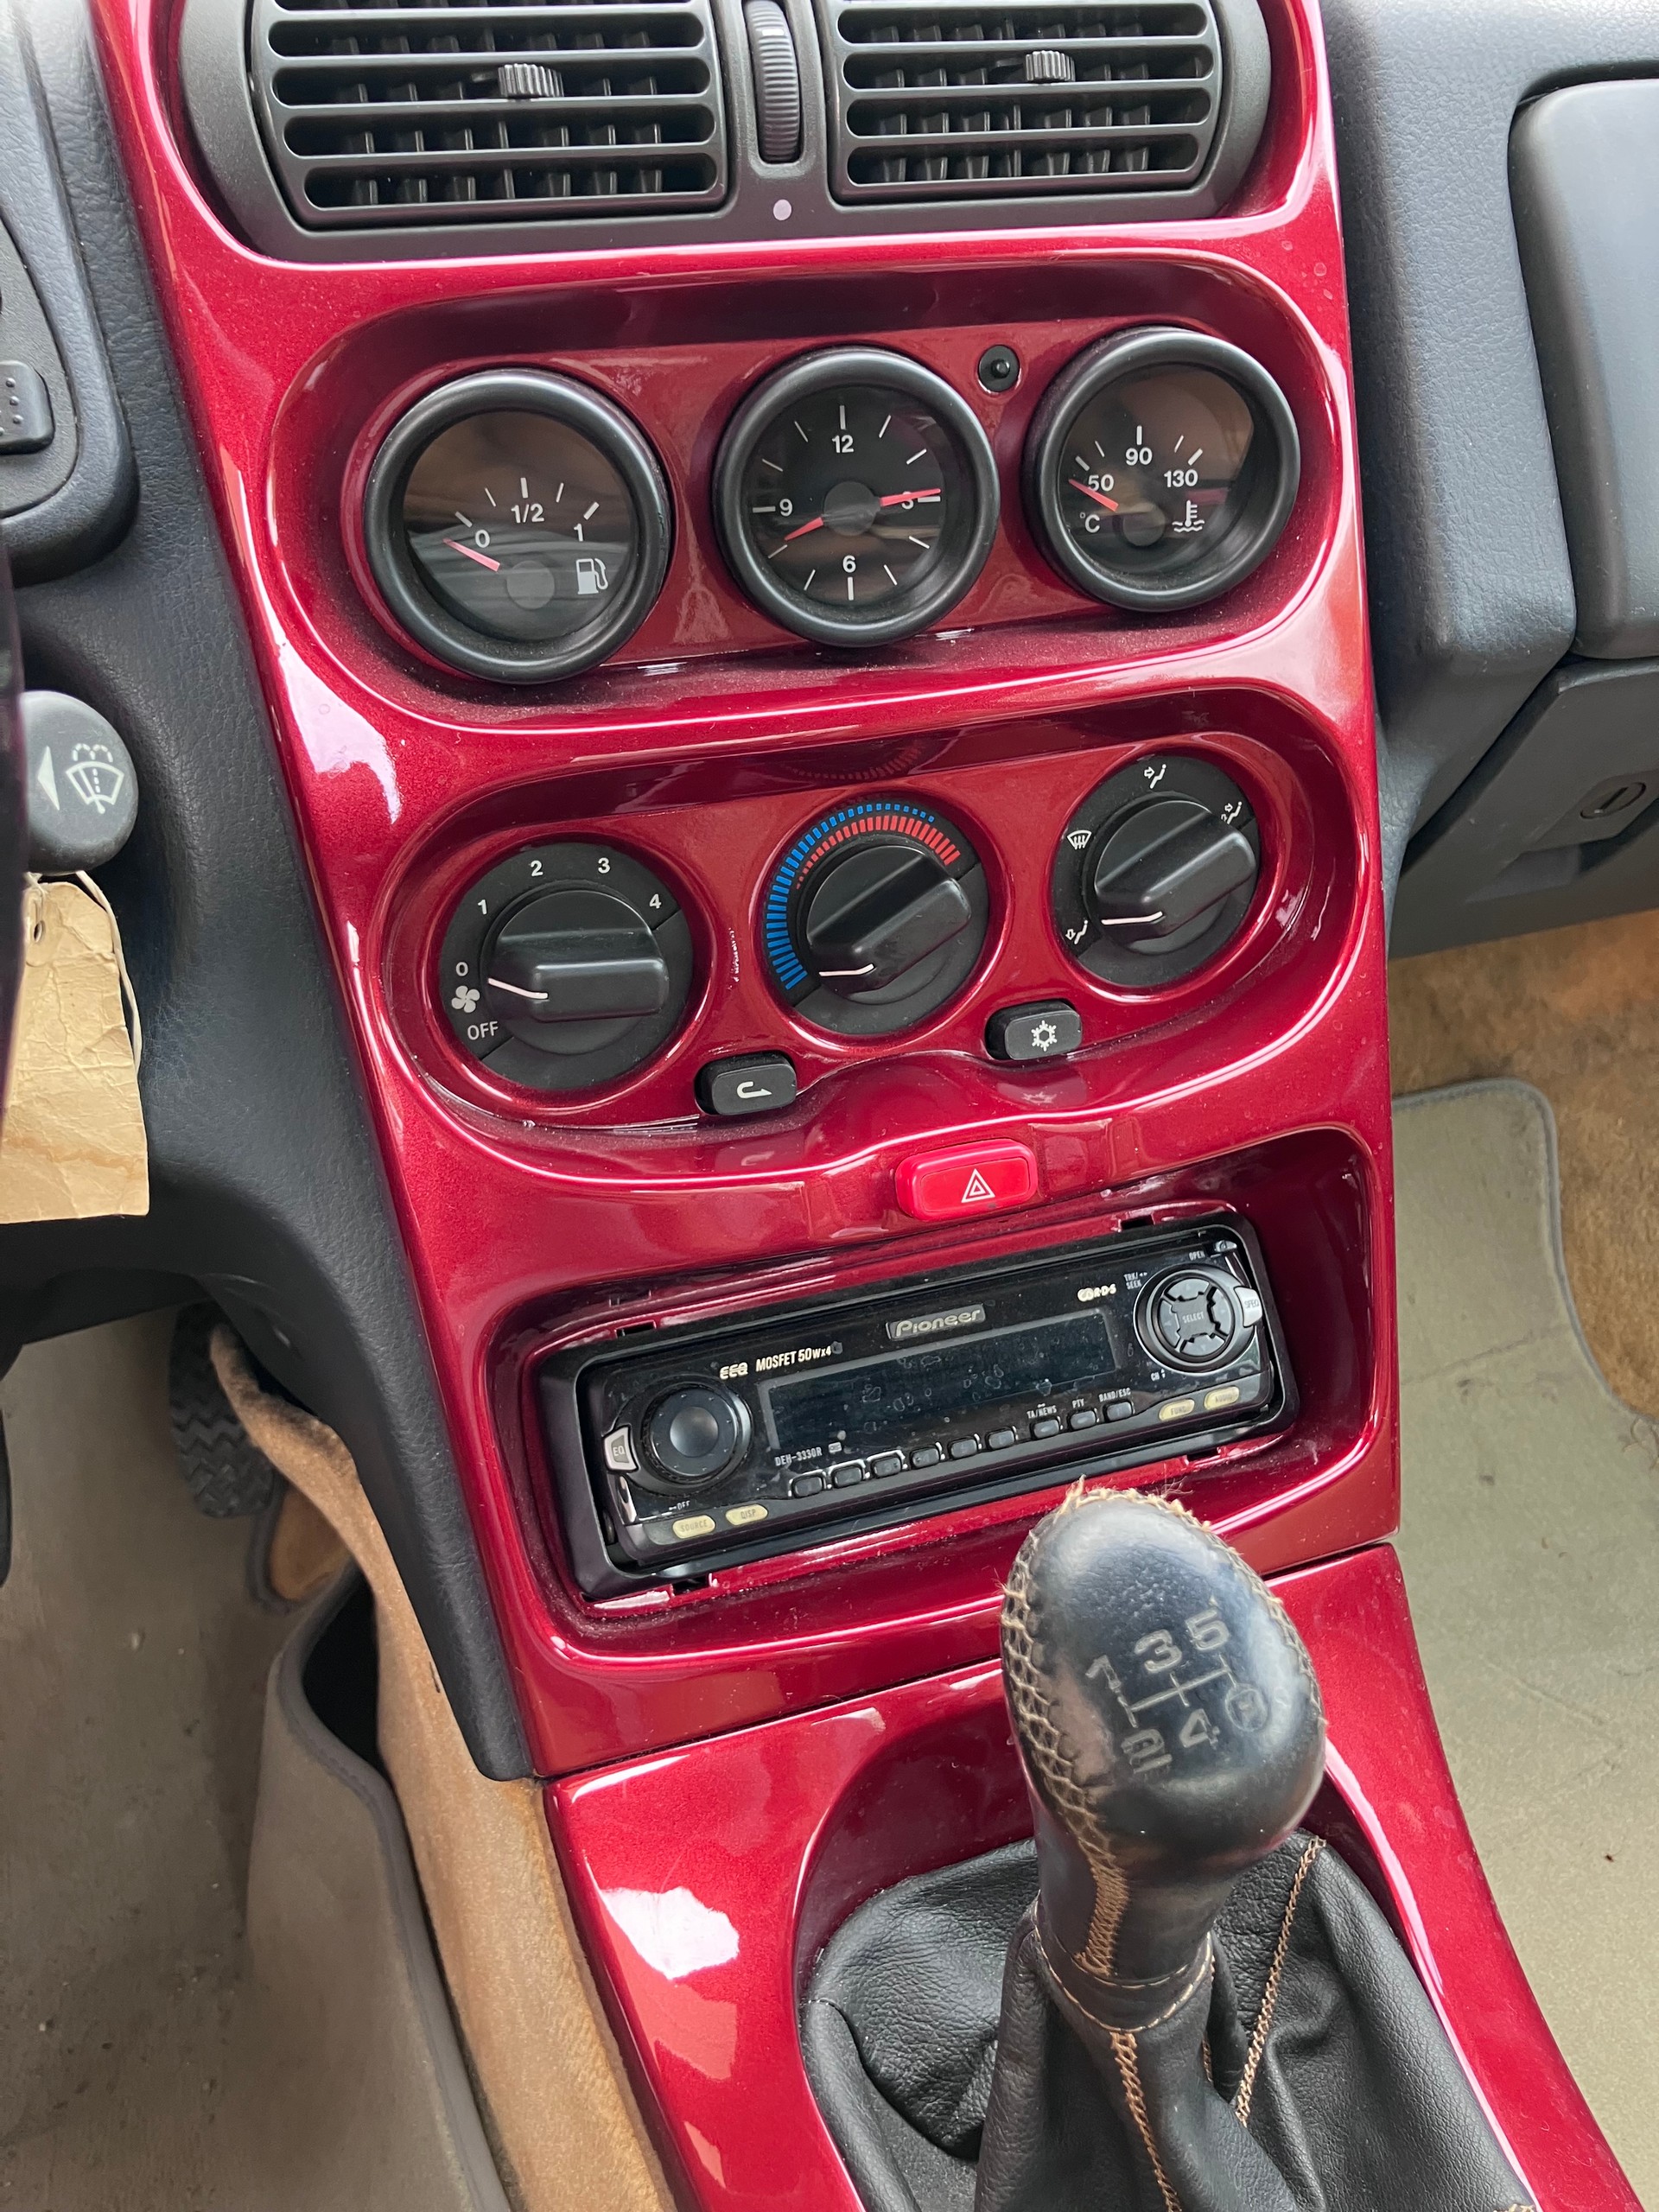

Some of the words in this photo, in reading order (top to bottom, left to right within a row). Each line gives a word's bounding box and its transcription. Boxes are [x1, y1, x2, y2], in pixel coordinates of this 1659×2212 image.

[831, 434, 855, 454] 12
[1125, 447, 1153, 467] 90
[1087, 474, 1115, 493] 50
[1163, 468, 1198, 488] 130
[511, 502, 545, 524] 1/2
[779, 498, 794, 518] 9
[474, 529, 491, 549] 0
[573, 523, 584, 542] 1
[842, 555, 856, 573] 6
[530, 860, 543, 877] 2
[597, 856, 611, 874] 3
[477, 899, 487, 915] 1
[649, 893, 662, 909] 4
[454, 961, 469, 977] 0
[467, 1020, 499, 1040] OFF
[1188, 1250, 1206, 1261] OPEN
[1126, 1281, 1142, 1290] SEEK
[895, 1307, 981, 1338] Pioneer
[1182, 1311, 1205, 1324] SELECT
[755, 1351, 798, 1372] MOSFET
[1071, 1398, 1085, 1408] PTY
[1098, 1387, 1132, 1402] BAND/ESC
[1026, 1405, 1058, 1420] TA/NEWS
[612, 1445, 625, 1457] EQ
[774, 1446, 823, 1466] DEH-3330R
[677, 1500, 690, 1510] OFF
[740, 1509, 757, 1520] DISP
[680, 1519, 709, 1533] SOURCE
[1185, 1608, 1230, 1651] 5
[1134, 1629, 1183, 1674] 3
[1084, 1655, 1122, 1694] 1
[1179, 1708, 1220, 1751] 4
